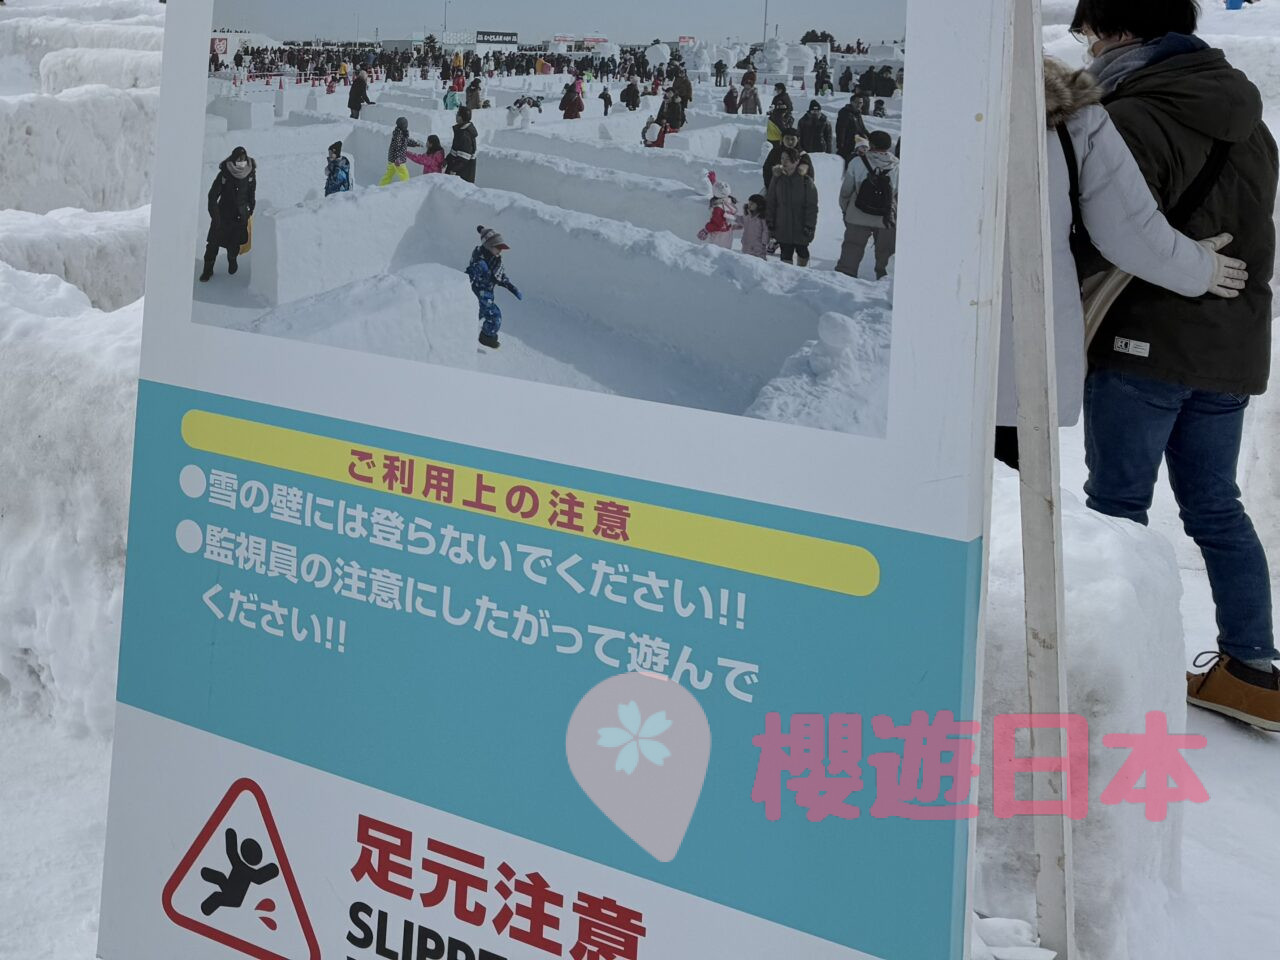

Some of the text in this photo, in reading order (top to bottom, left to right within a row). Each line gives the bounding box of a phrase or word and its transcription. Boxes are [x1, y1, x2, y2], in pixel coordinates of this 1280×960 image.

[348, 448, 632, 543] ご利用上の注意
[350, 813, 647, 960] 足元注意
